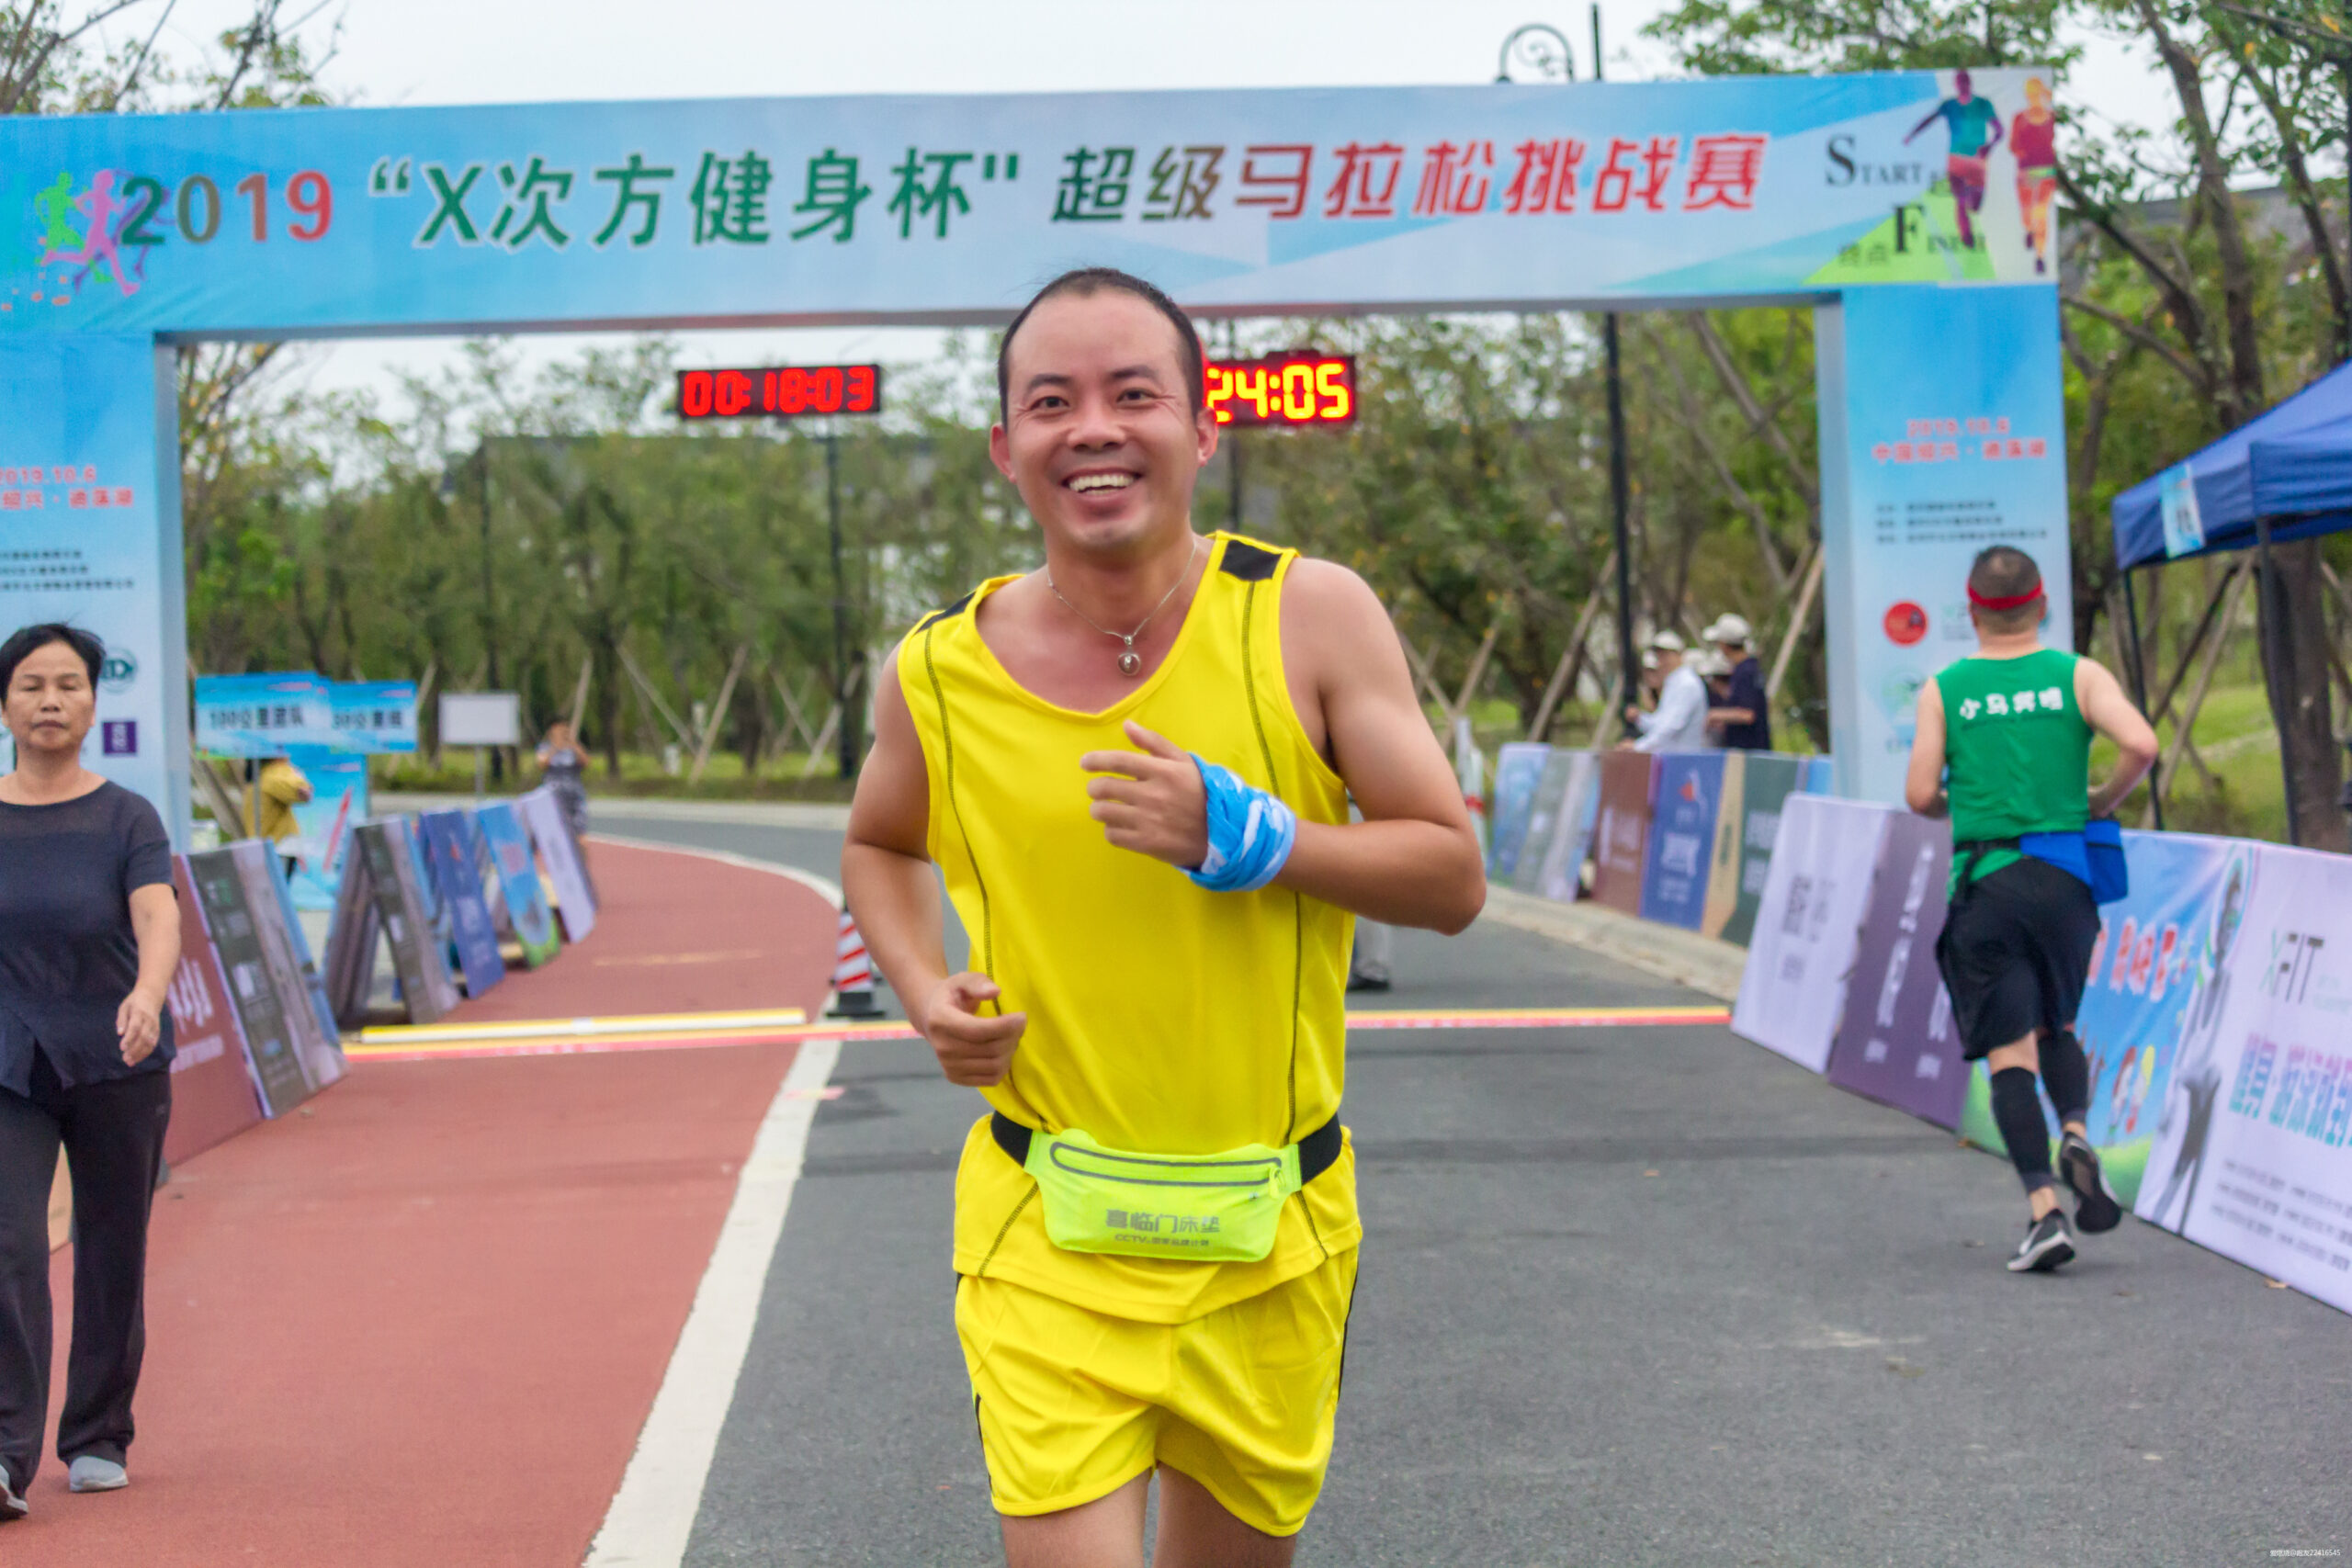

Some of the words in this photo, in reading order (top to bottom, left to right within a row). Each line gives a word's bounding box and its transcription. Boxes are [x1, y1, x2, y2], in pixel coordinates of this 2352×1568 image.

[1825, 134, 1922, 186] START
[120, 171, 334, 246] 2019
[1050, 134, 1769, 222] 超级马拉松挑战赛
[684, 366, 874, 416] 00:18:03
[1206, 362, 1350, 423] 24:05
[0, 465, 96, 485] 019.10.6
